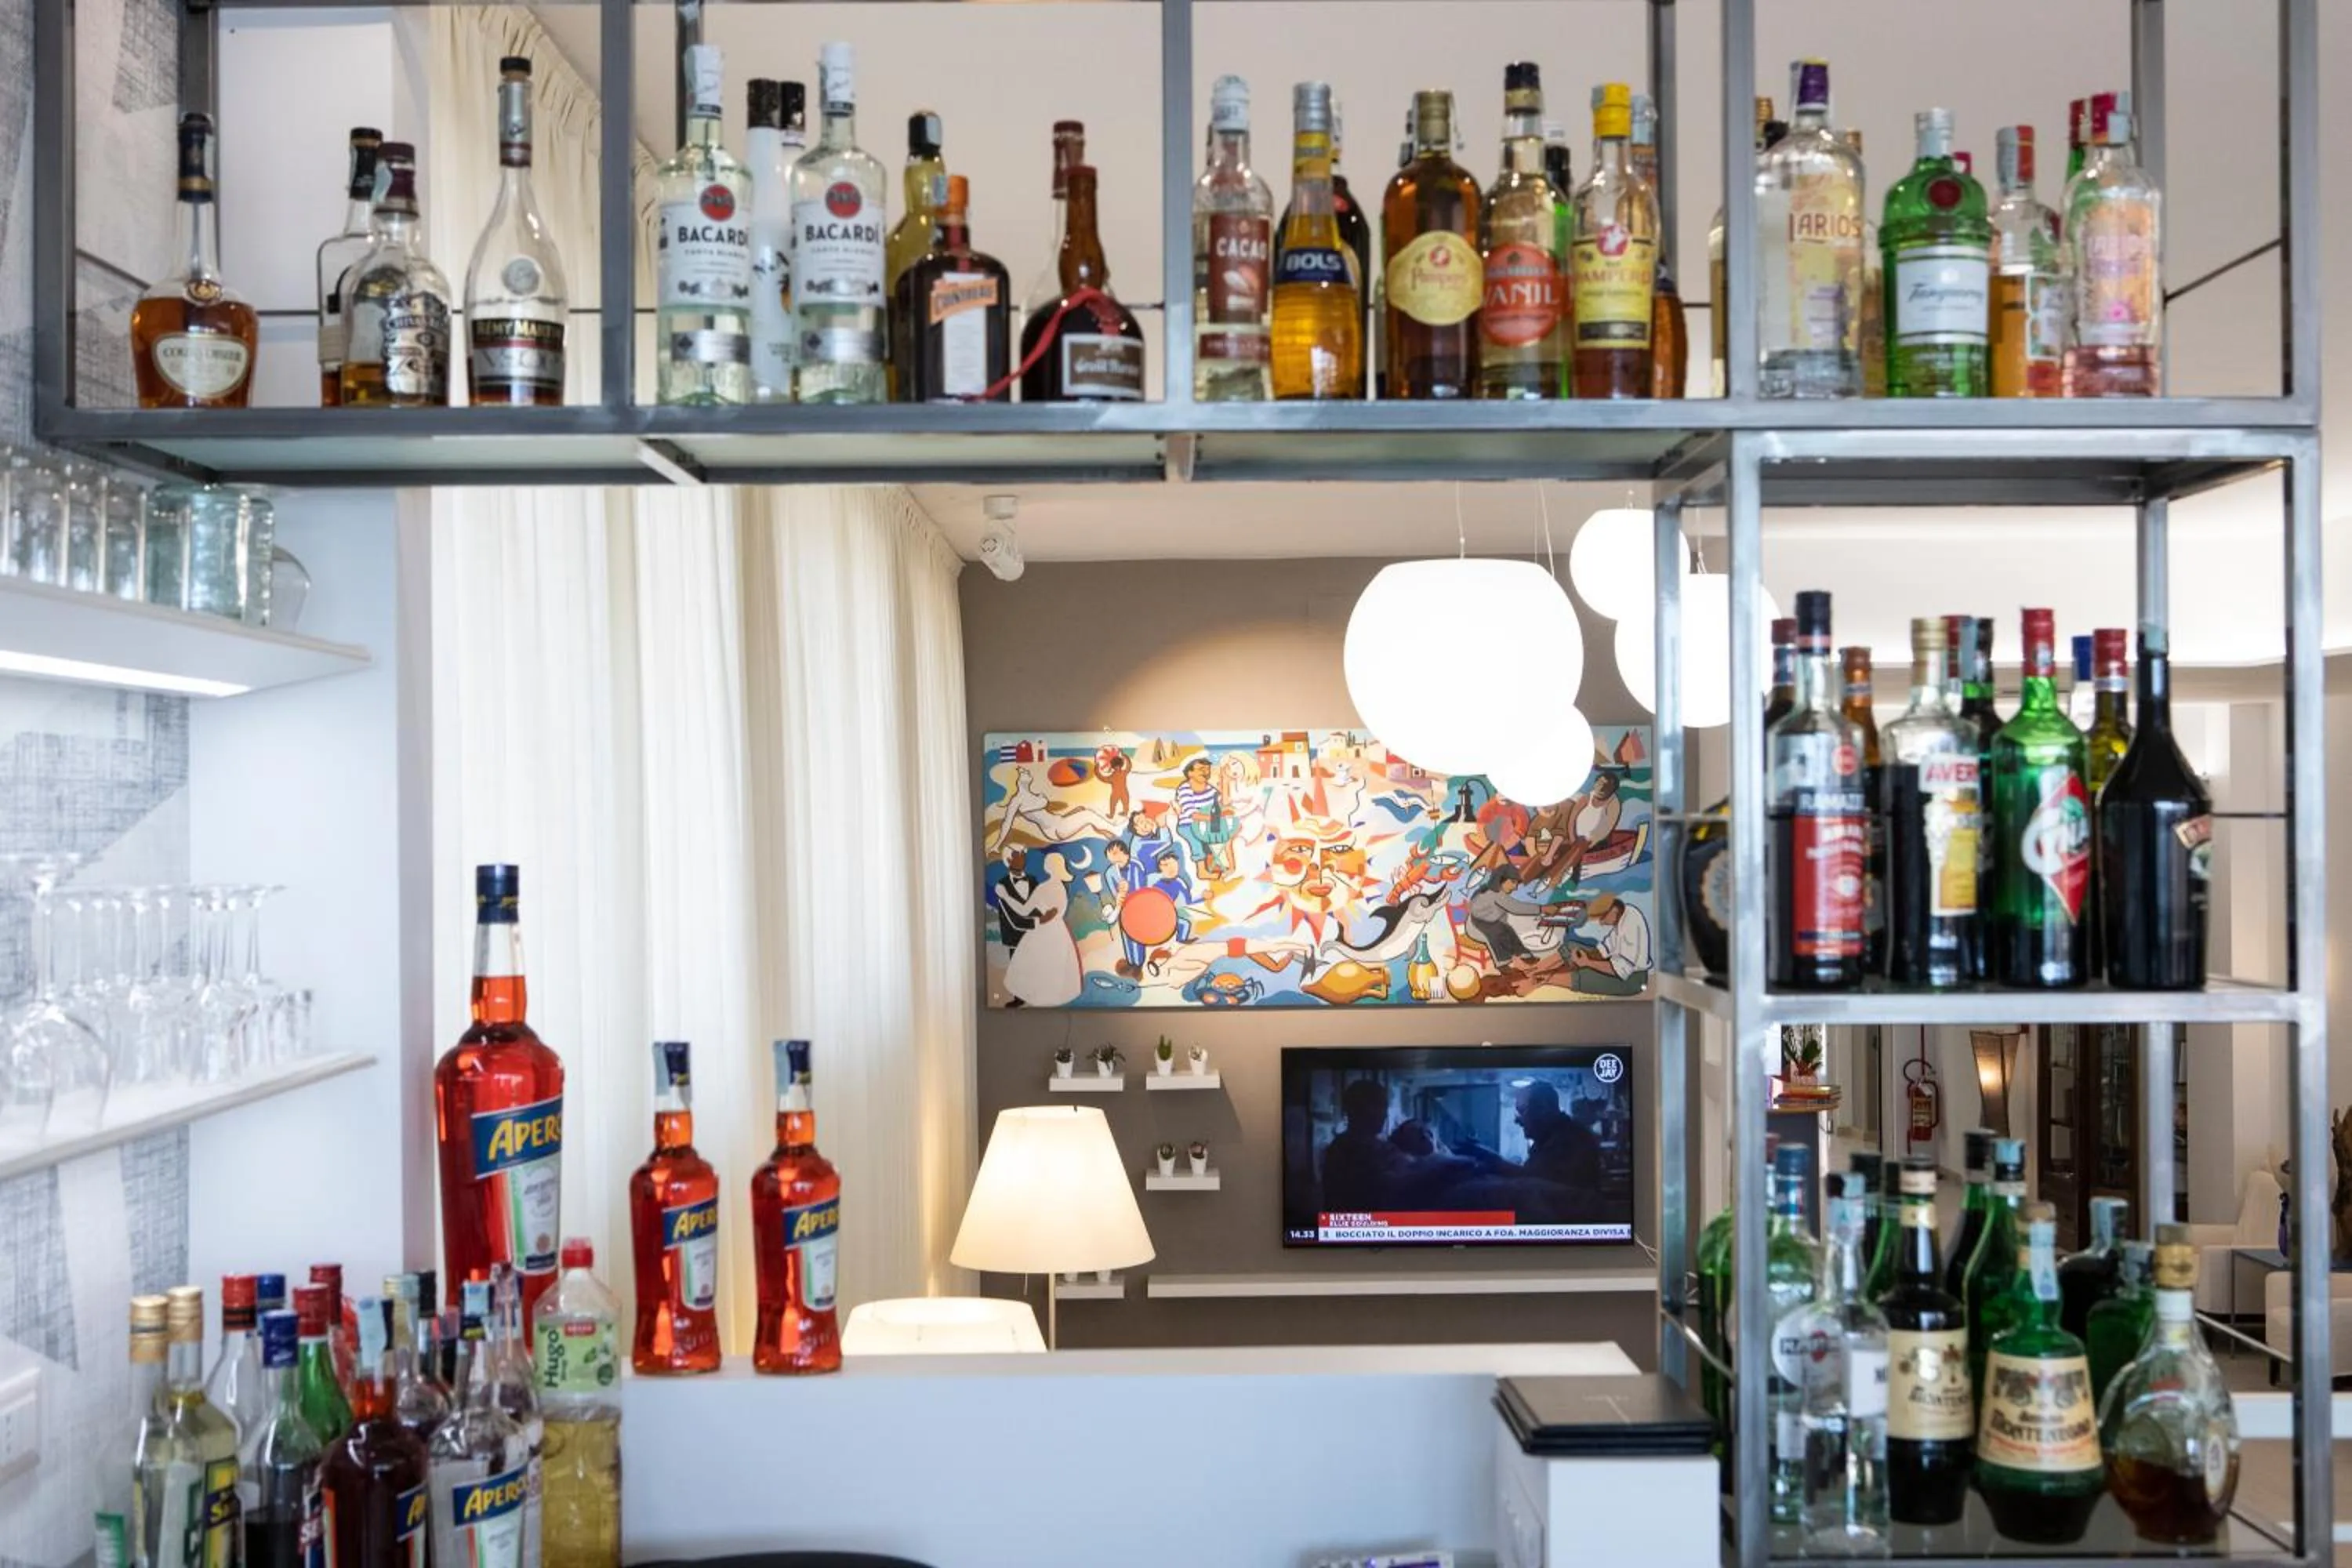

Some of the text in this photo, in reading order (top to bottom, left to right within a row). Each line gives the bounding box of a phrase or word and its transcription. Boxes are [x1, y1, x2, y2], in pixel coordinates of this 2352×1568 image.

[1286, 252, 1341, 271] BOLS
[1335, 1229, 1385, 1238] BOCCIATO
[1387, 1229, 1395, 1238] IL
[1398, 1229, 1434, 1238] DOPPIO
[1436, 1229, 1483, 1238] INCARICO
[1484, 1229, 1492, 1237] A
[1519, 1229, 1591, 1237] MAGGIORANZA
[1592, 1229, 1625, 1237] DIVISA
[544, 1329, 565, 1388] Hugo
